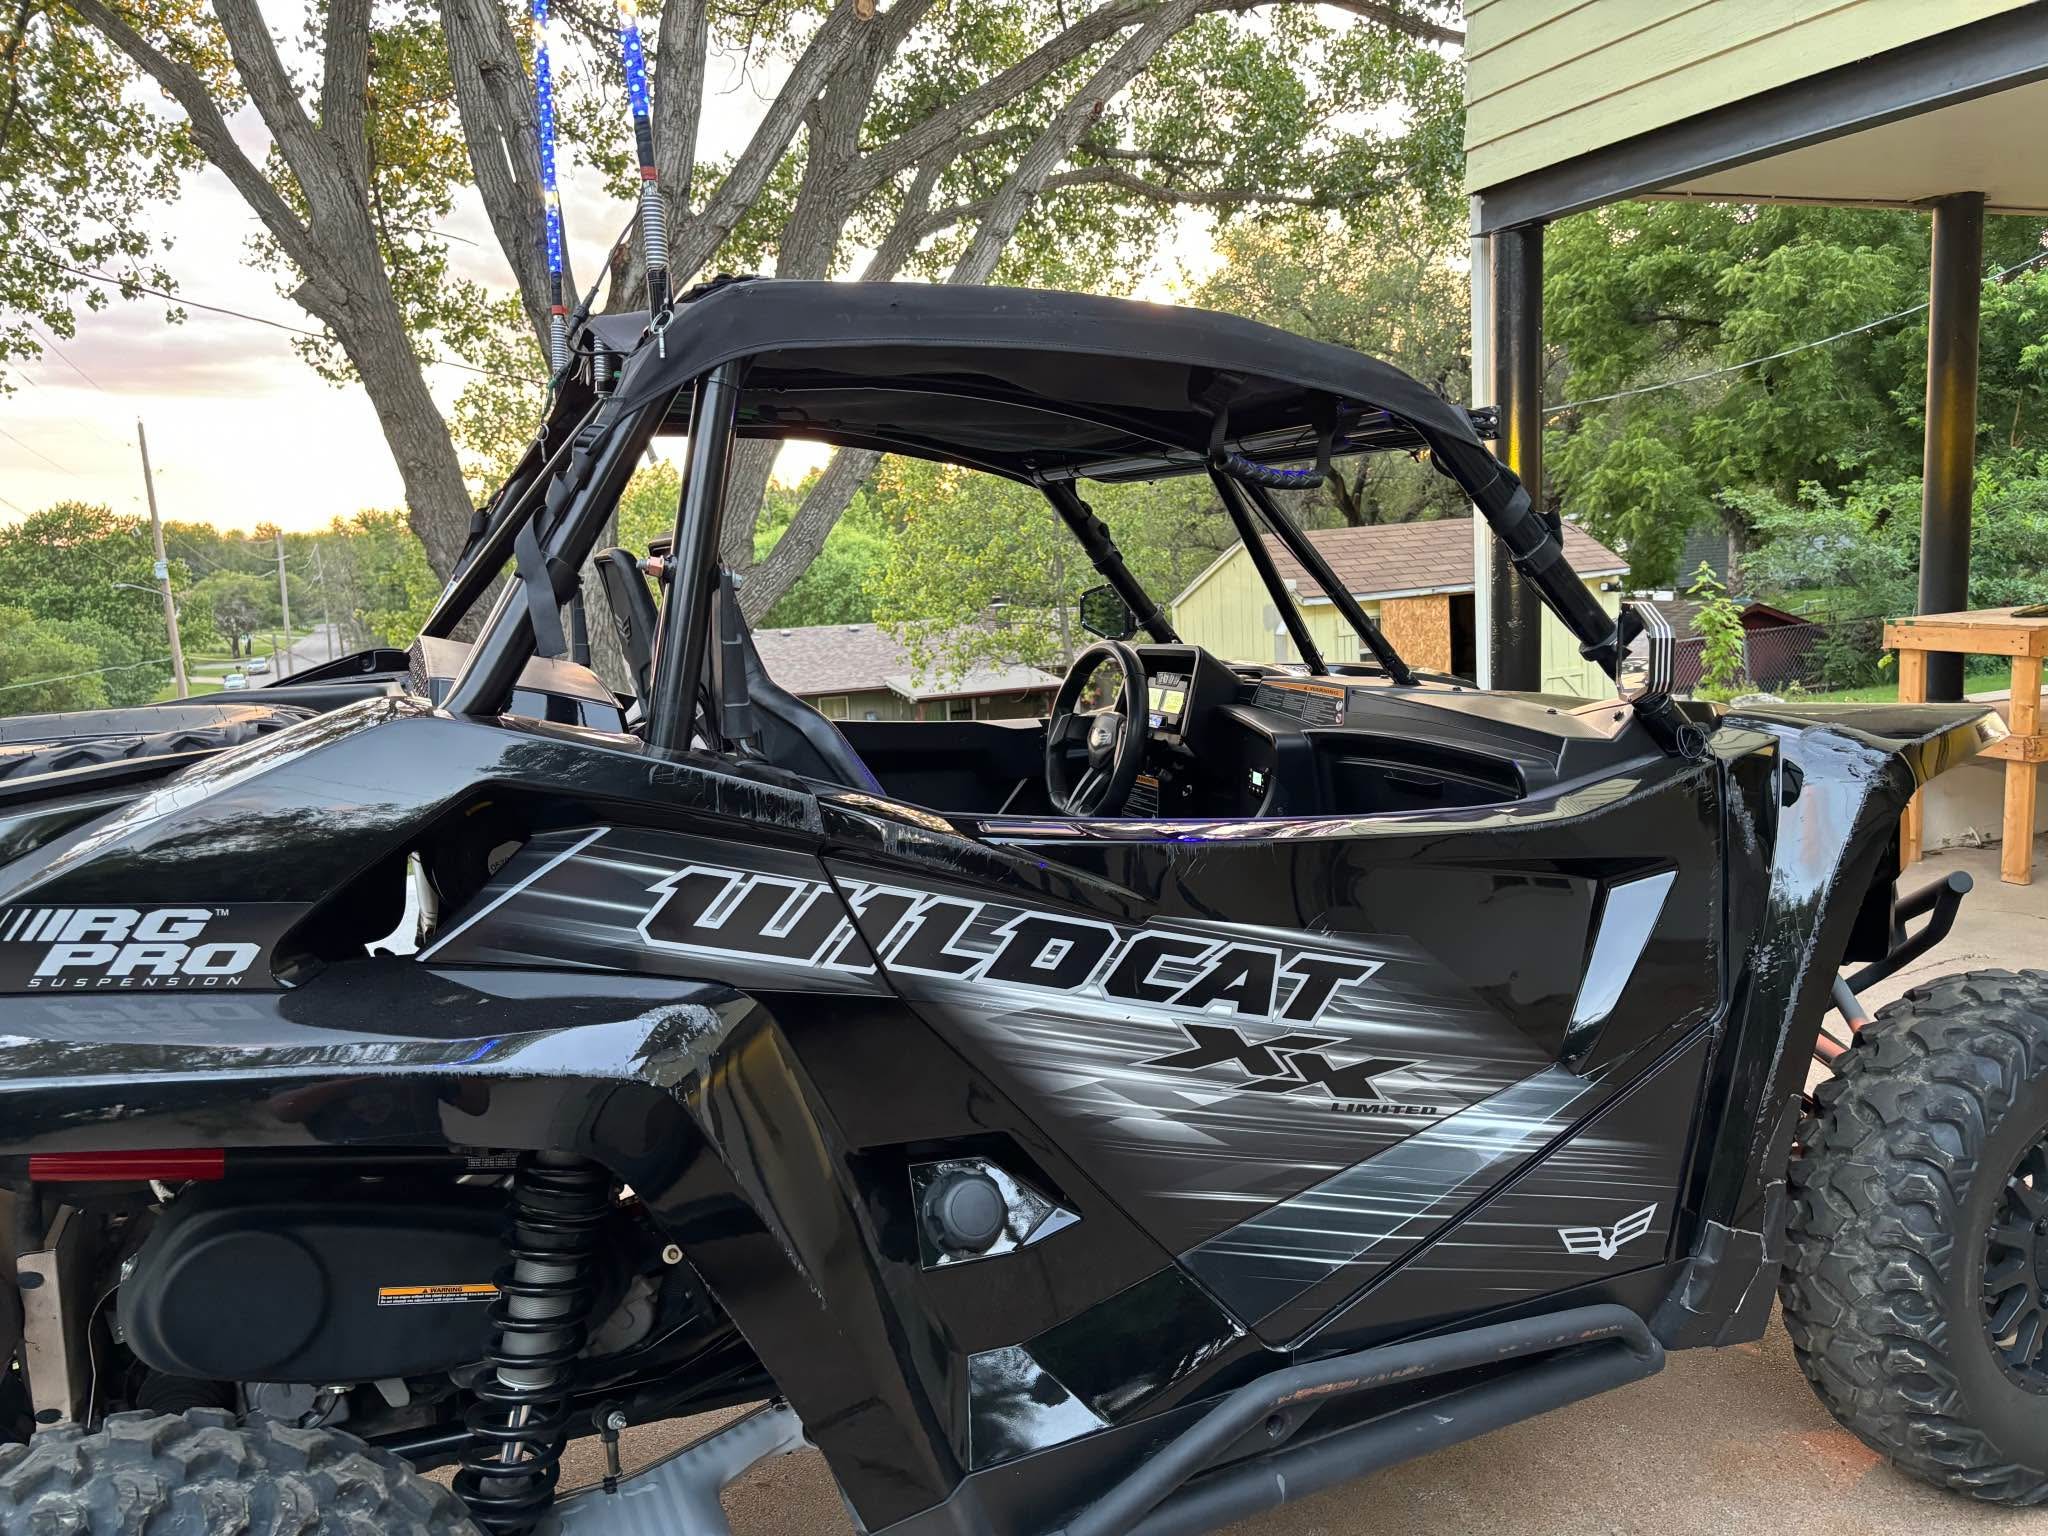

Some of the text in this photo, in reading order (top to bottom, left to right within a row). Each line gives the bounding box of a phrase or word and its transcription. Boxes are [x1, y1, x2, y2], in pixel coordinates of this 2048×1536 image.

[55, 908, 214, 942] RG
[33, 942, 262, 977] PRO
[637, 865, 1386, 1027] WILDCAT
[27, 976, 243, 988] SUSPENSION
[1127, 1017, 1431, 1103] XX
[1330, 1102, 1438, 1116] LIMITED
[430, 1286, 464, 1294] WARNING
